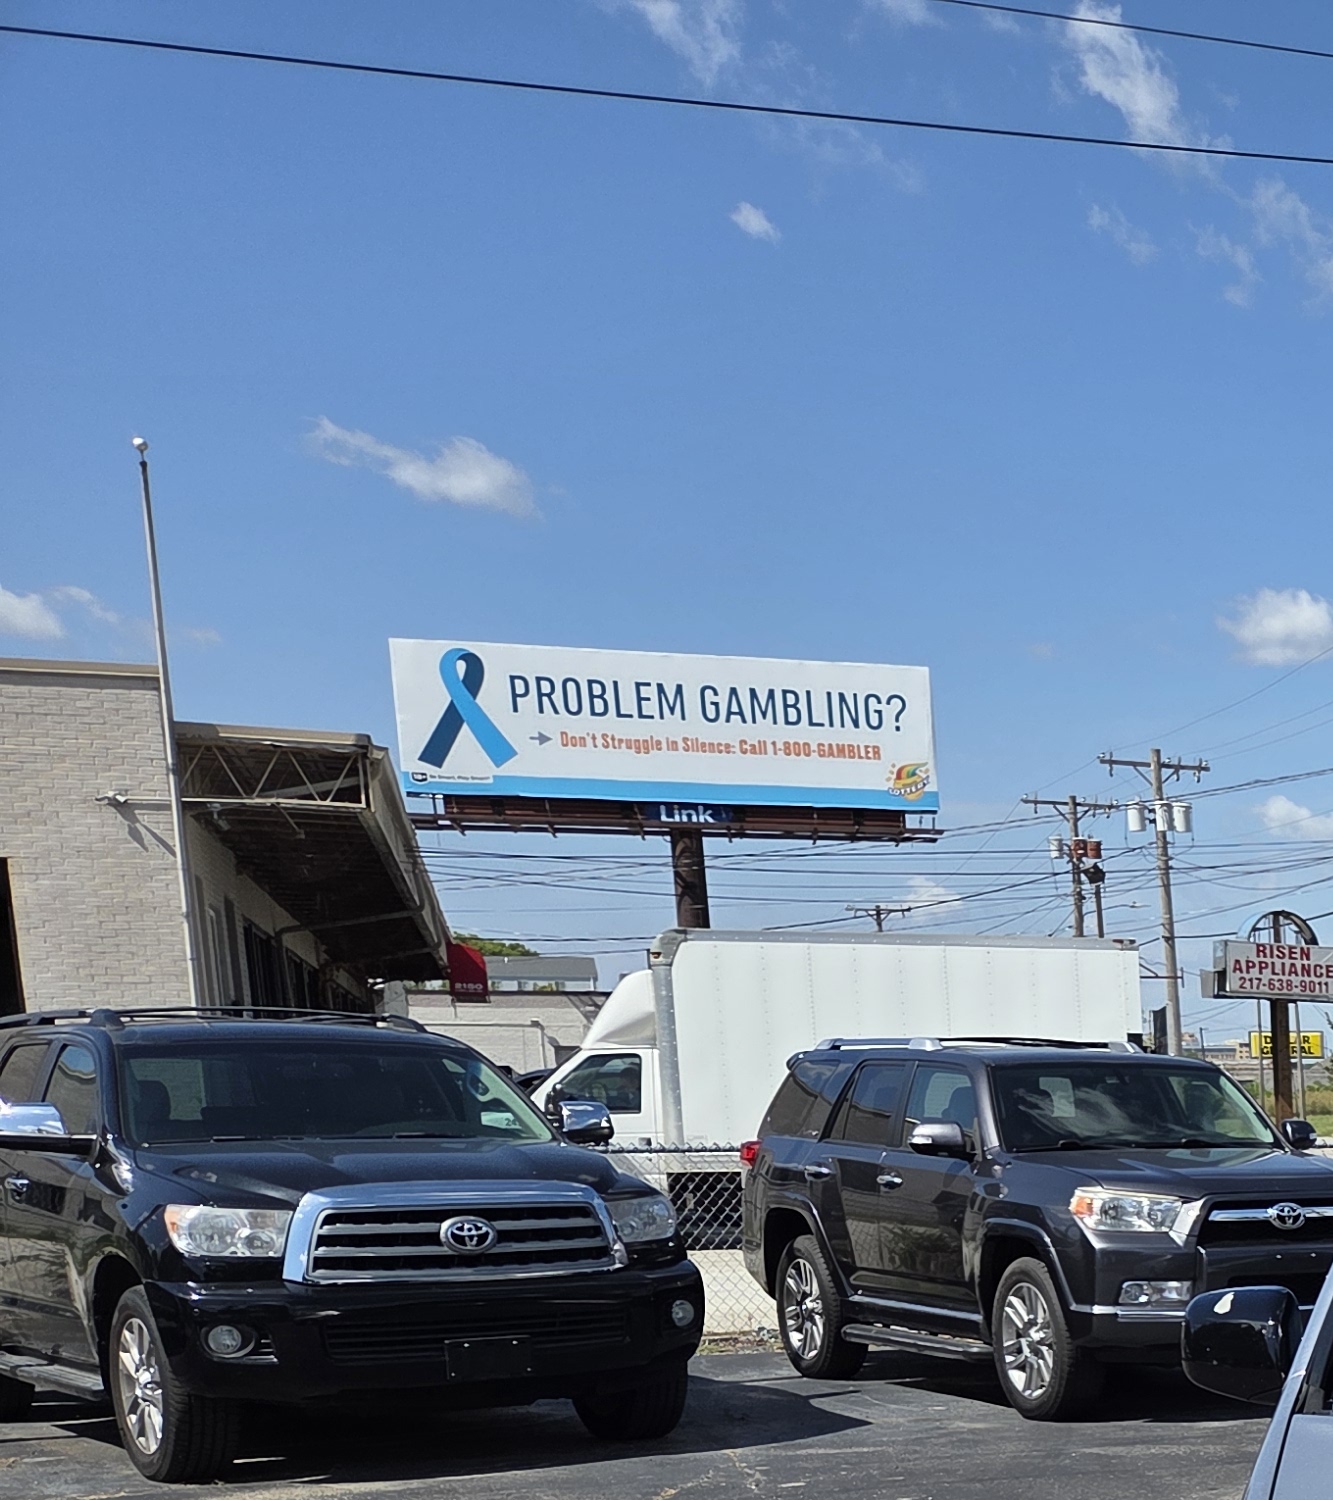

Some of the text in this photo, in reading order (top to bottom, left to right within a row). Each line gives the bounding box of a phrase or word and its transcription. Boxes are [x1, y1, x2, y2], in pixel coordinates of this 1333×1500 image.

[509, 675, 906, 732] PROBLEM GAMBLING?
[560, 731, 881, 760] Don't Struggle in Silence: Call 1-800-GAMBLER
[660, 804, 718, 823] Link
[1256, 943, 1311, 960] RISEN
[1239, 976, 1329, 993] 217-638-9011
